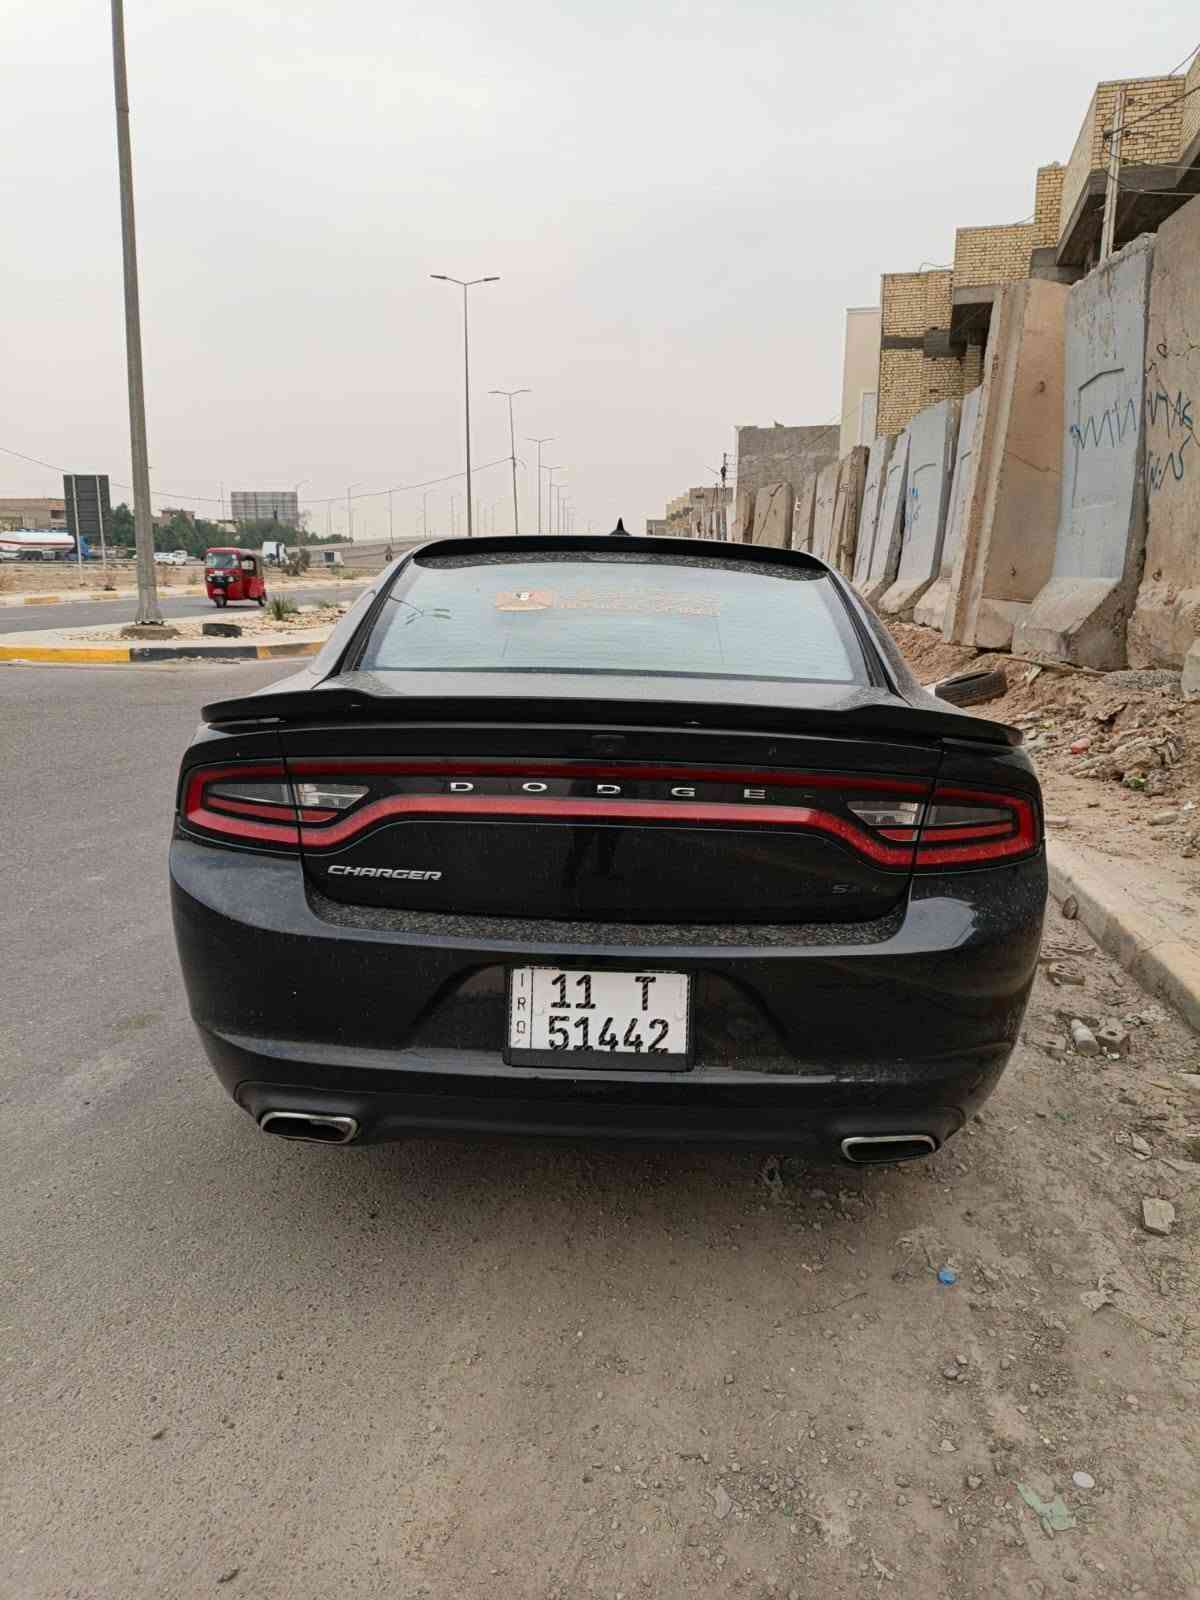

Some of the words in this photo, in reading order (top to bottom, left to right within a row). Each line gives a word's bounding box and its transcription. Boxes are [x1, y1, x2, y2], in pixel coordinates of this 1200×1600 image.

[450, 782, 767, 799] DODGE
[328, 865, 442, 880] CHARGER
[551, 974, 596, 1009] 11
[635, 976, 656, 1011] T
[549, 1016, 669, 1054] 51442
